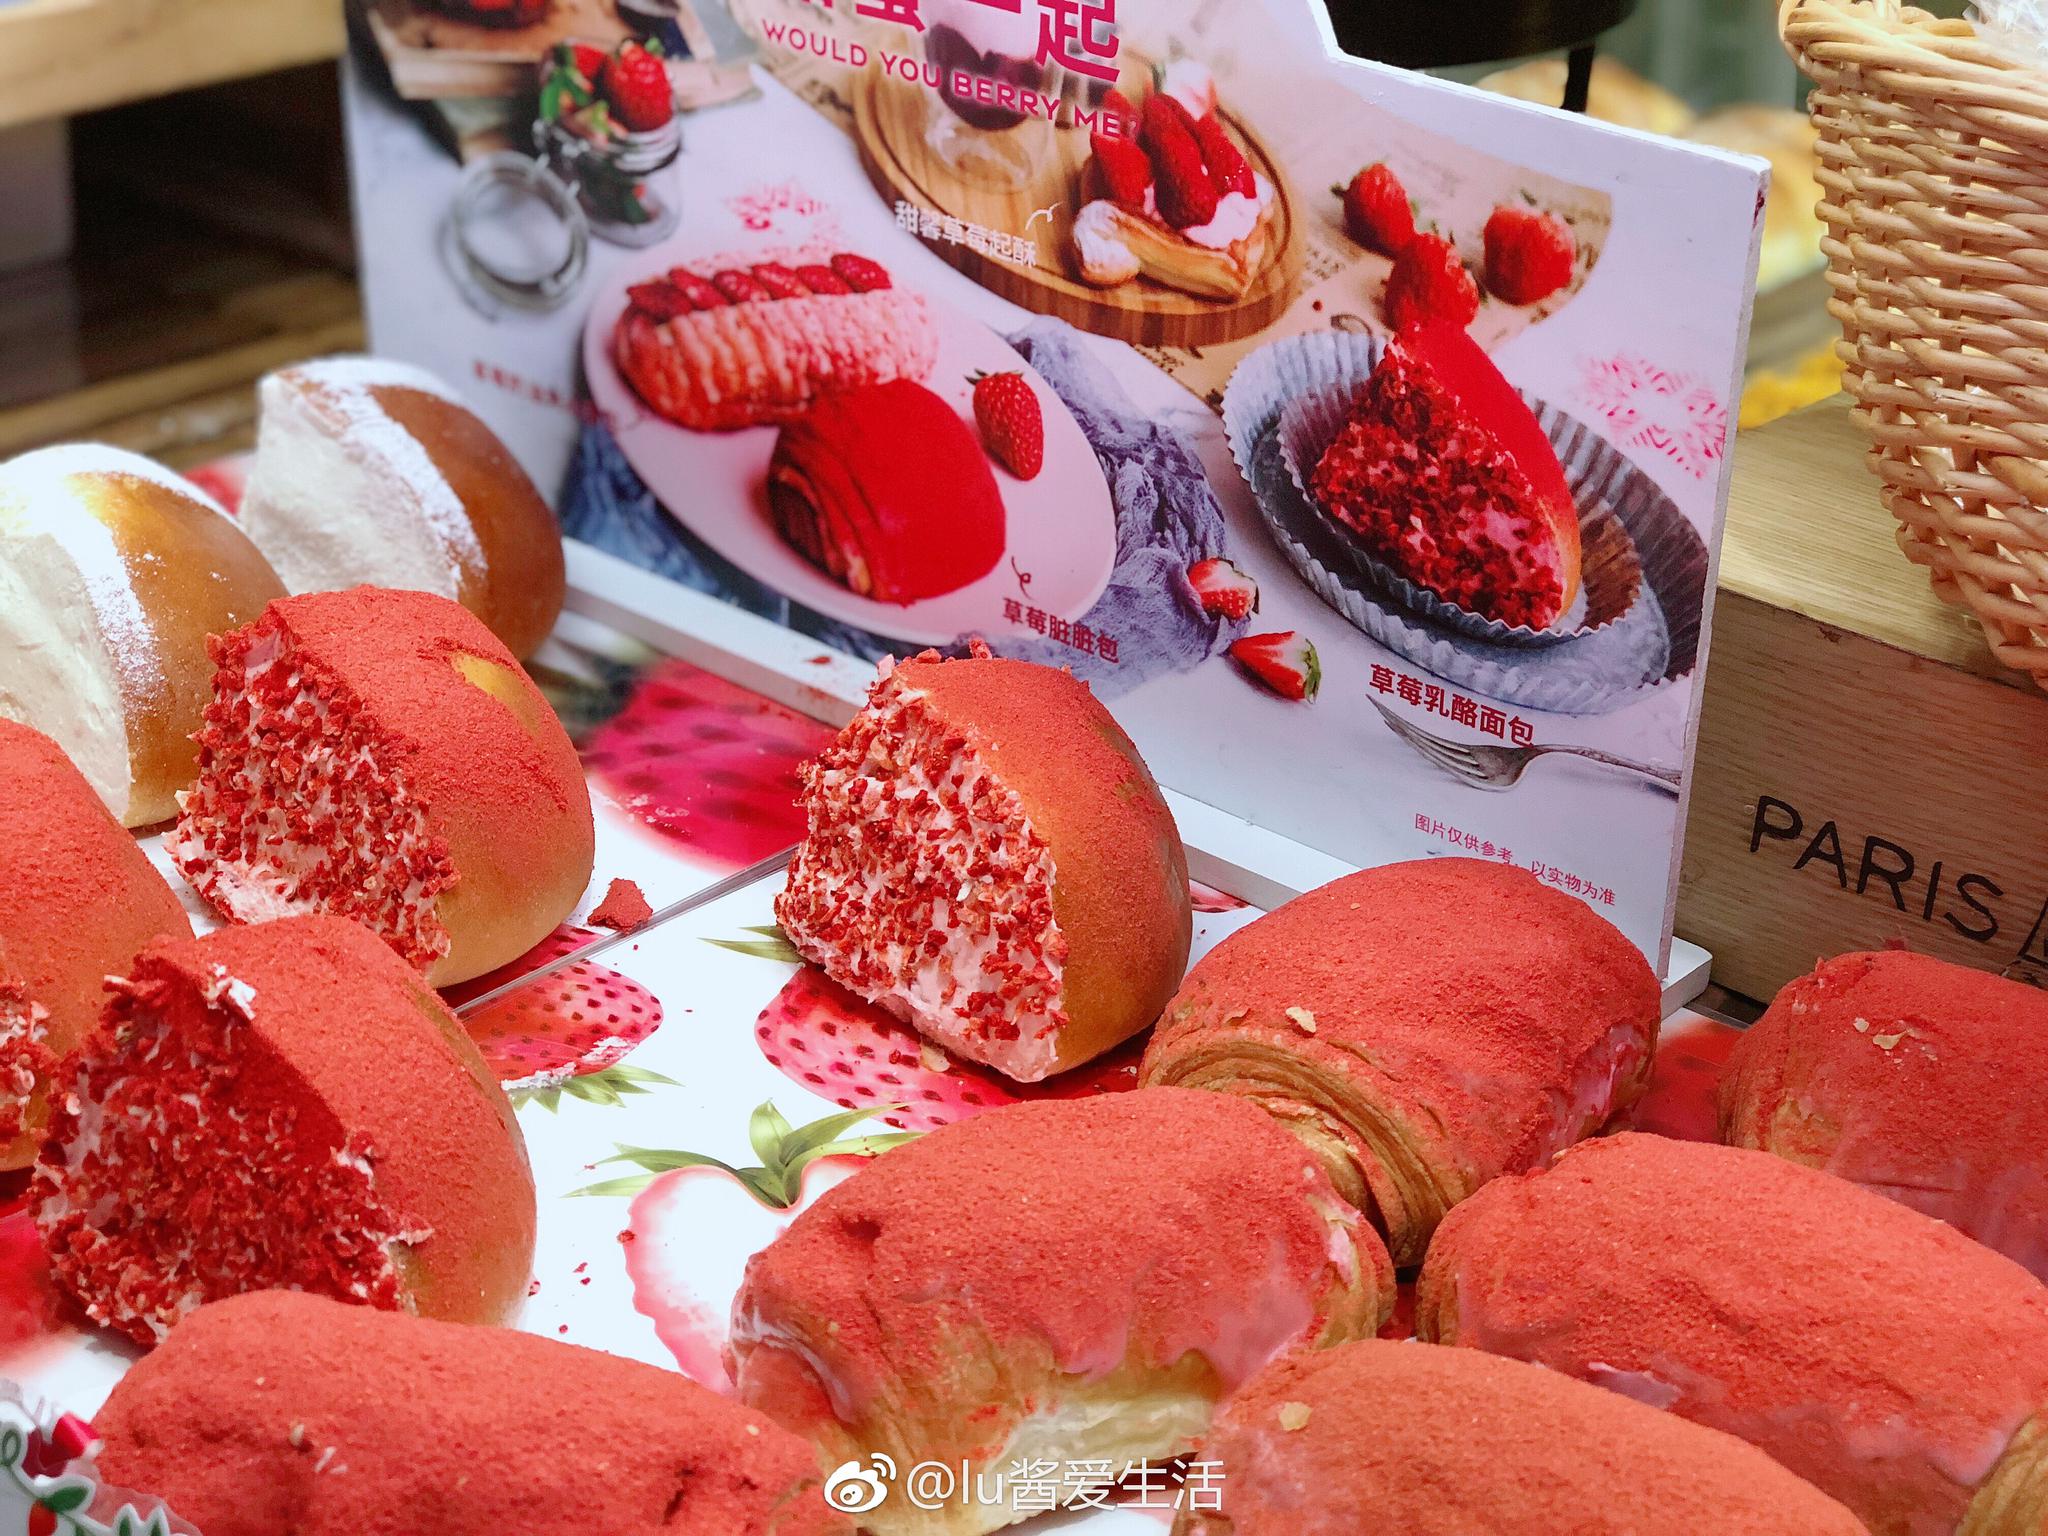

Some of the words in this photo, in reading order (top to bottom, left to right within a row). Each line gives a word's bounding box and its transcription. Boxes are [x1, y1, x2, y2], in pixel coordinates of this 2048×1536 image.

[761, 18, 868, 67] WOULD
[880, 50, 942, 88] YOU
[953, 71, 1061, 121] BERRY
[1003, 597, 1120, 664] 草莓脏脏包
[1369, 663, 1534, 749] 草莓乳酪面包
[1750, 795, 2004, 942] PARIS
